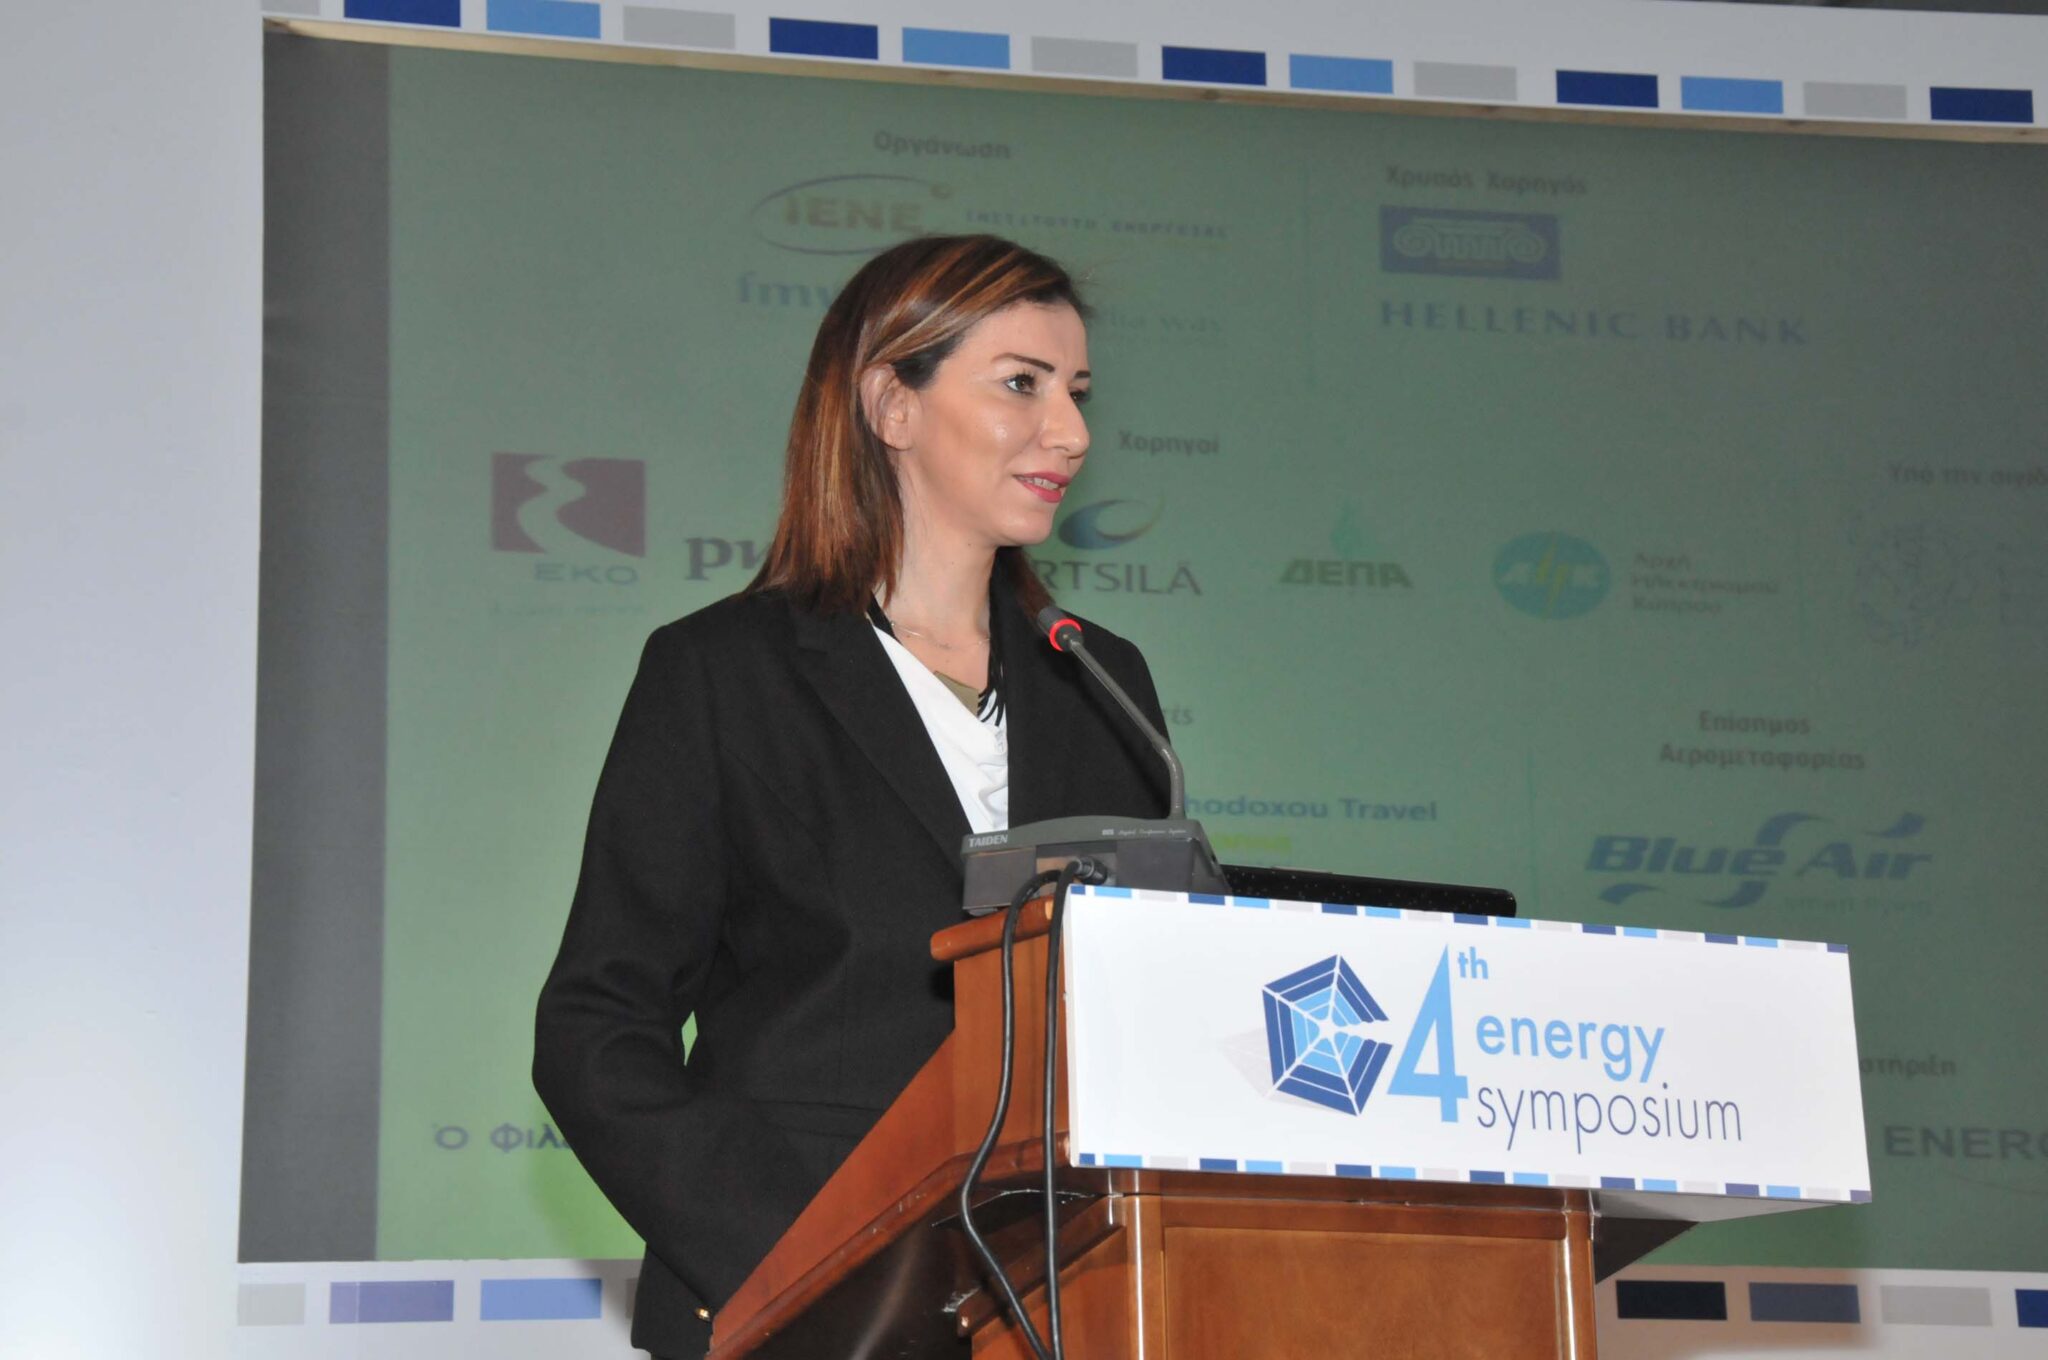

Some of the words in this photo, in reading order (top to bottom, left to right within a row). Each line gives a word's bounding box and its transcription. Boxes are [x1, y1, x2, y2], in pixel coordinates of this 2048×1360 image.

[1380, 299, 1639, 340] HELLENIC
[1665, 313, 1807, 346] BANK
[533, 561, 639, 586] EKO
[1032, 557, 1204, 598] RTSILÄ
[1185, 795, 1329, 819] hodoxou
[1338, 797, 1439, 821] Travel
[967, 833, 1009, 848] TAIDEN
[1584, 834, 1788, 879] Blue
[1793, 841, 1934, 881] Air
[1476, 1014, 1665, 1083] energy
[1477, 1081, 1742, 1155] symposium
